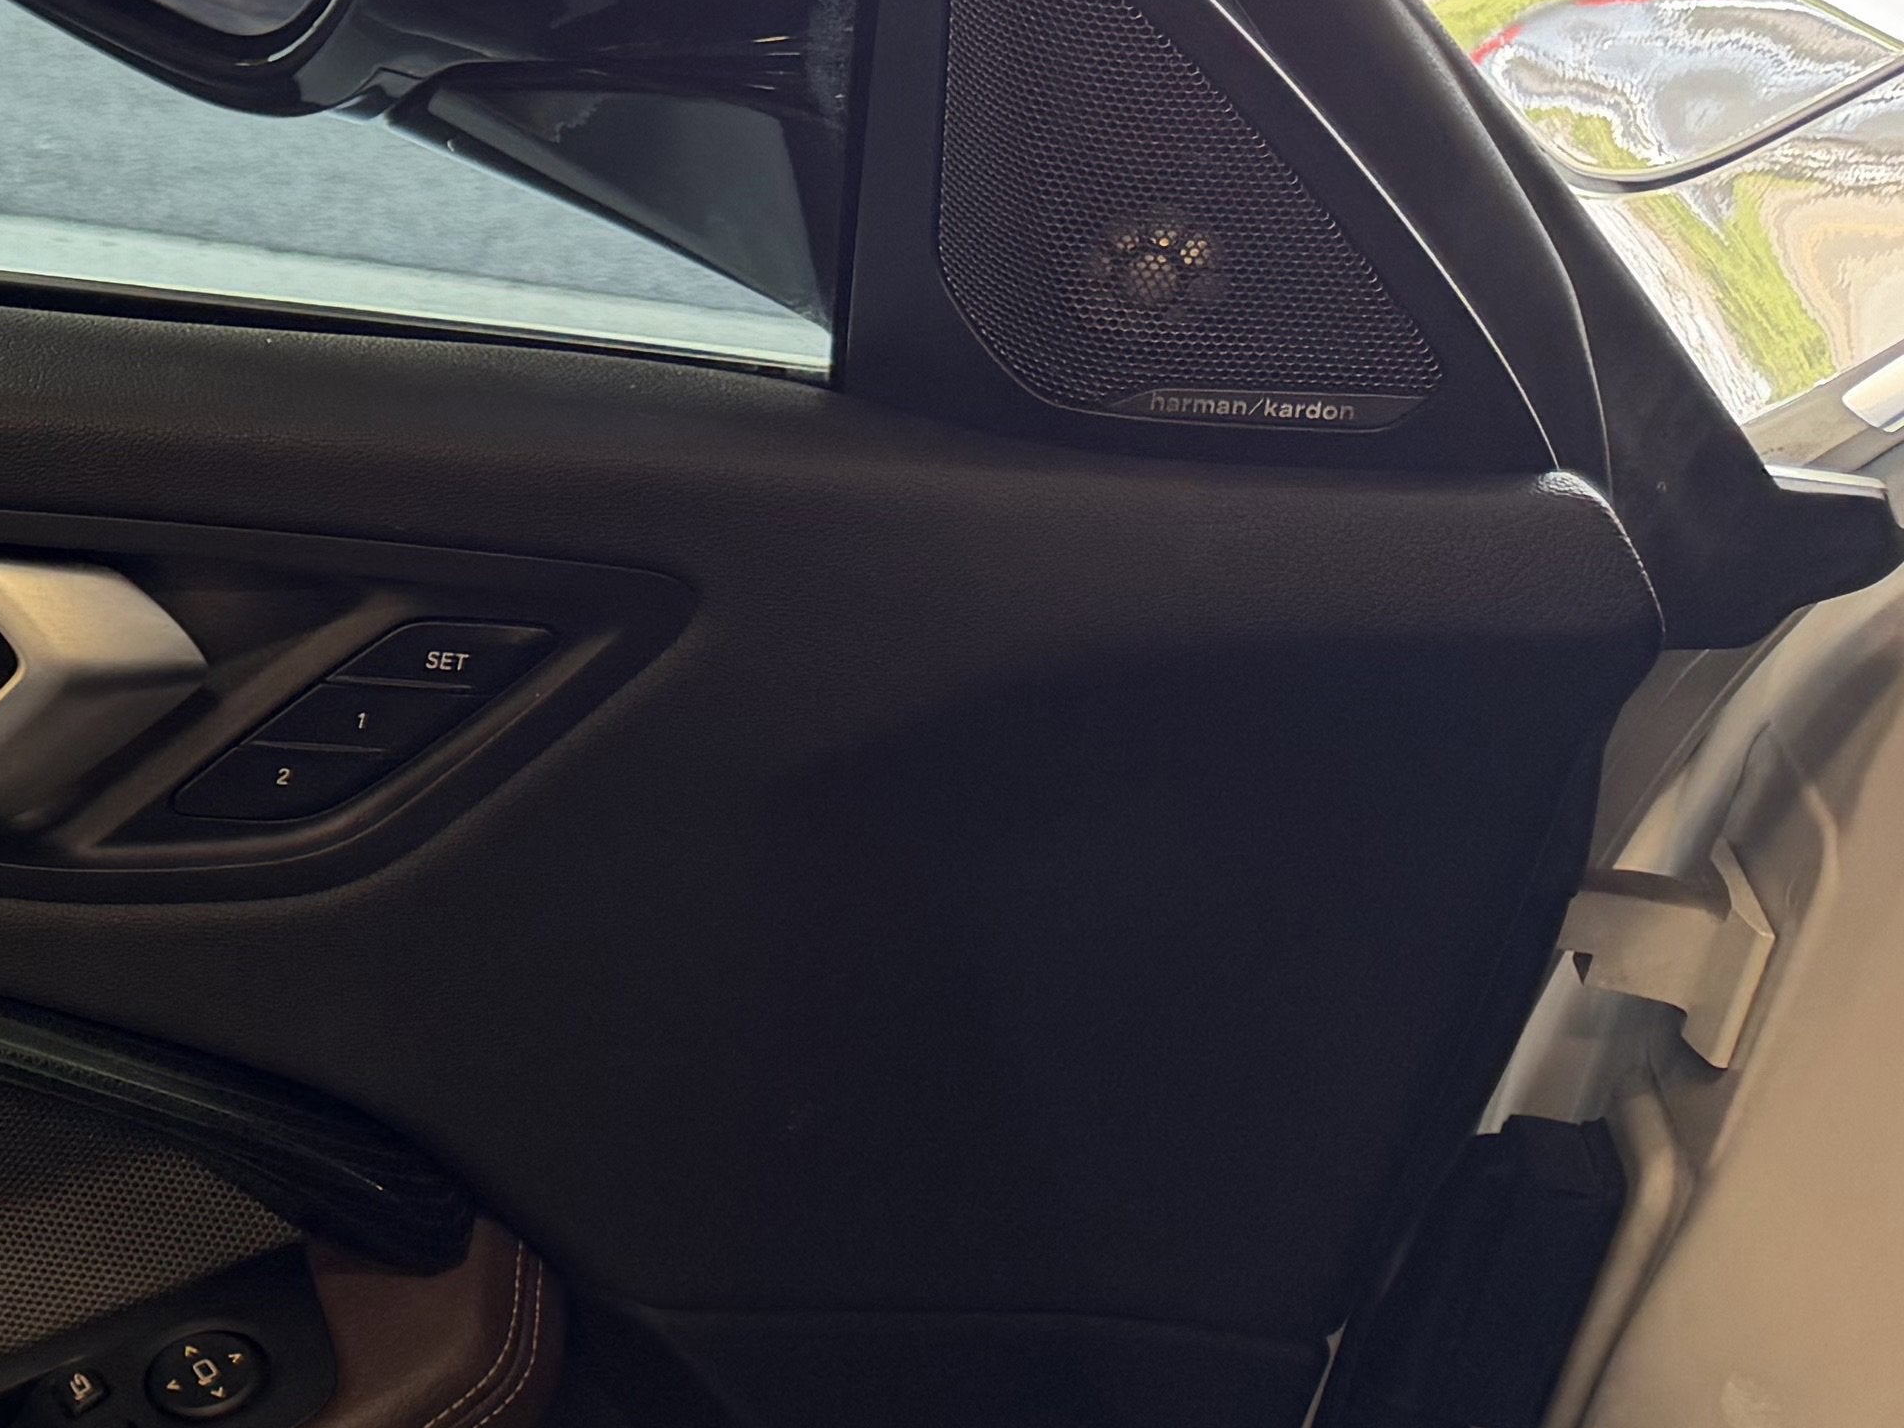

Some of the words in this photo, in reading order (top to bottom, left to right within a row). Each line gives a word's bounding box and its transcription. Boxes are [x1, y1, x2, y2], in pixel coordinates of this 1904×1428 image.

[1150, 392, 1354, 420] harman/kardon
[425, 651, 469, 672] SET
[356, 712, 366, 729] 1
[276, 768, 290, 785] 2
